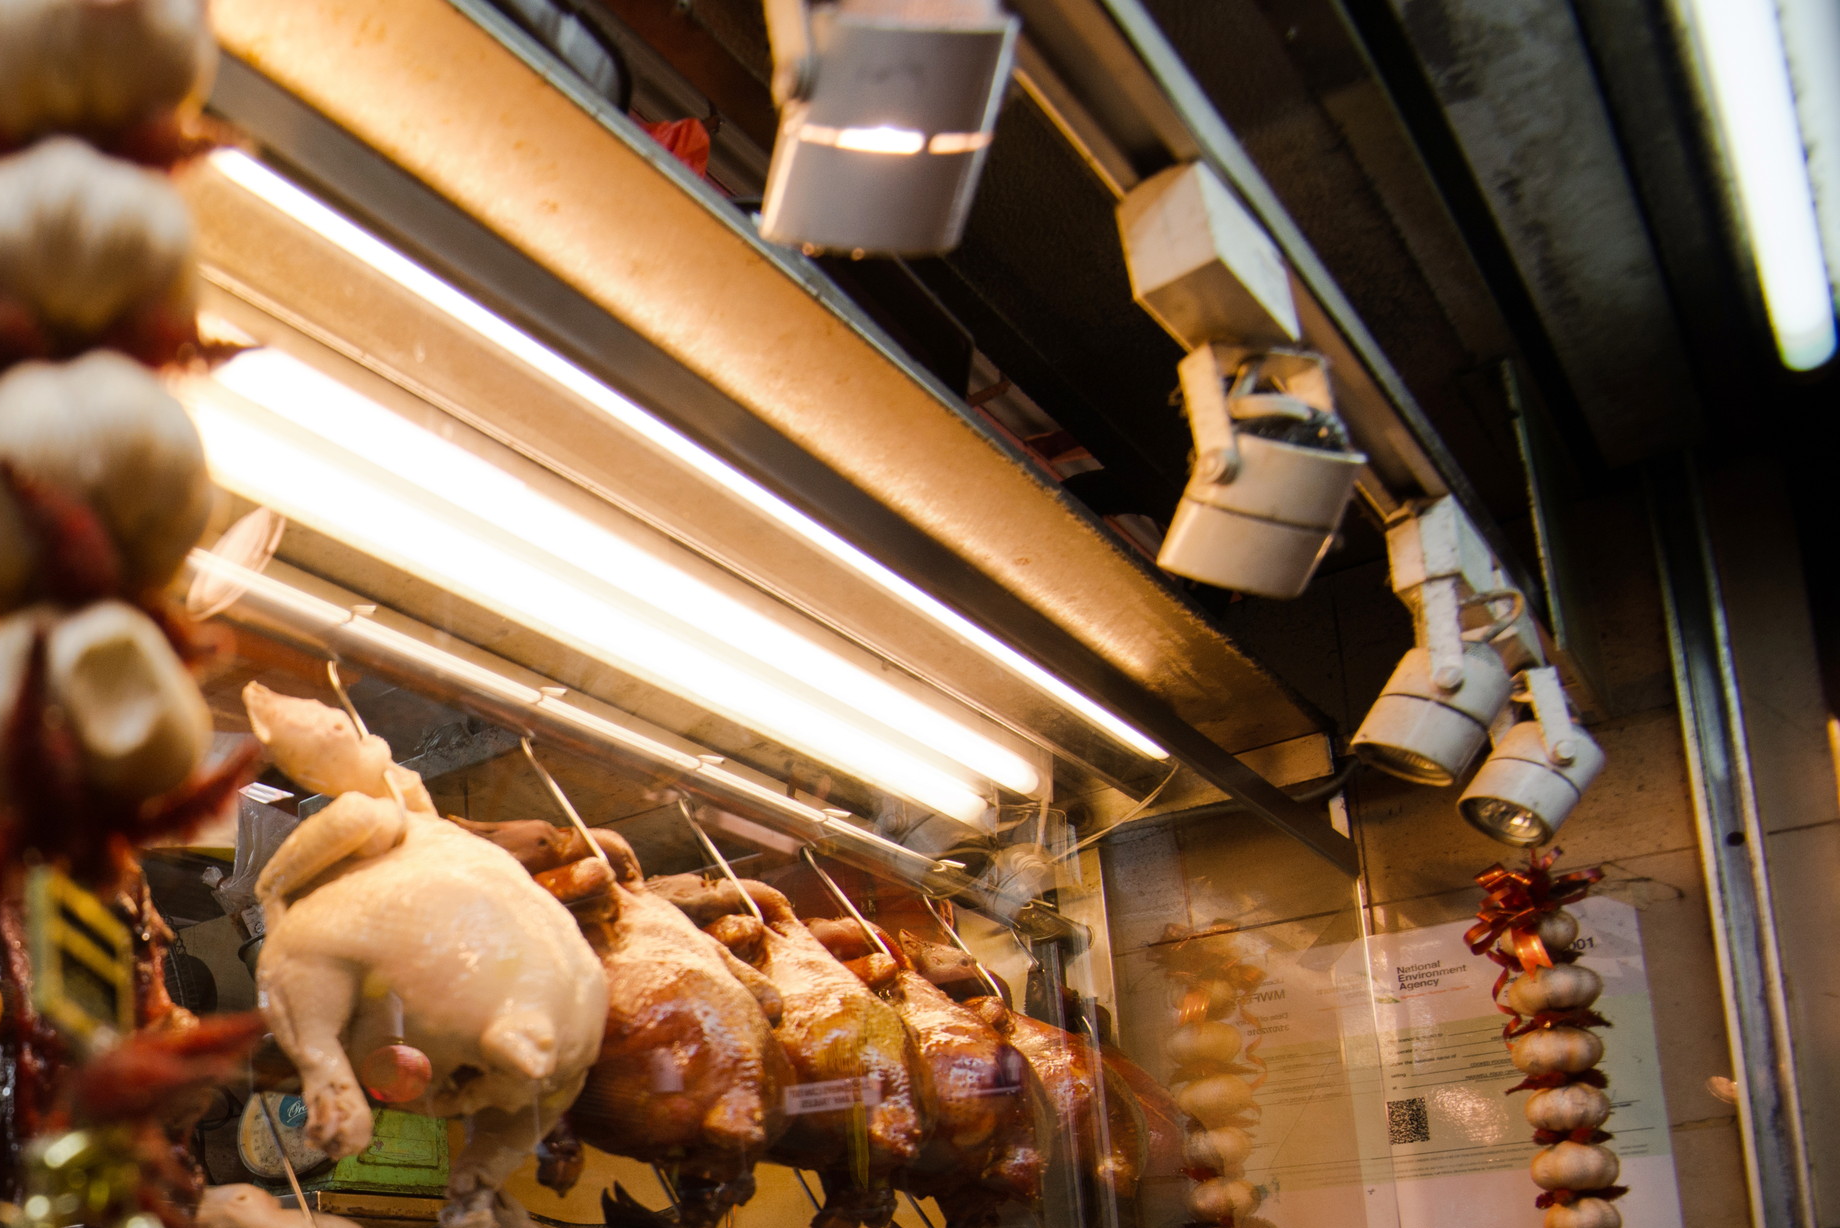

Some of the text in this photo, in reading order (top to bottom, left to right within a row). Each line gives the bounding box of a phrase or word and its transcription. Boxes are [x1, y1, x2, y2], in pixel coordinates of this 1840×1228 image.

[1396, 960, 1440, 975] National
[1397, 965, 1467, 983] Environment
[1399, 978, 1440, 992] Agency
